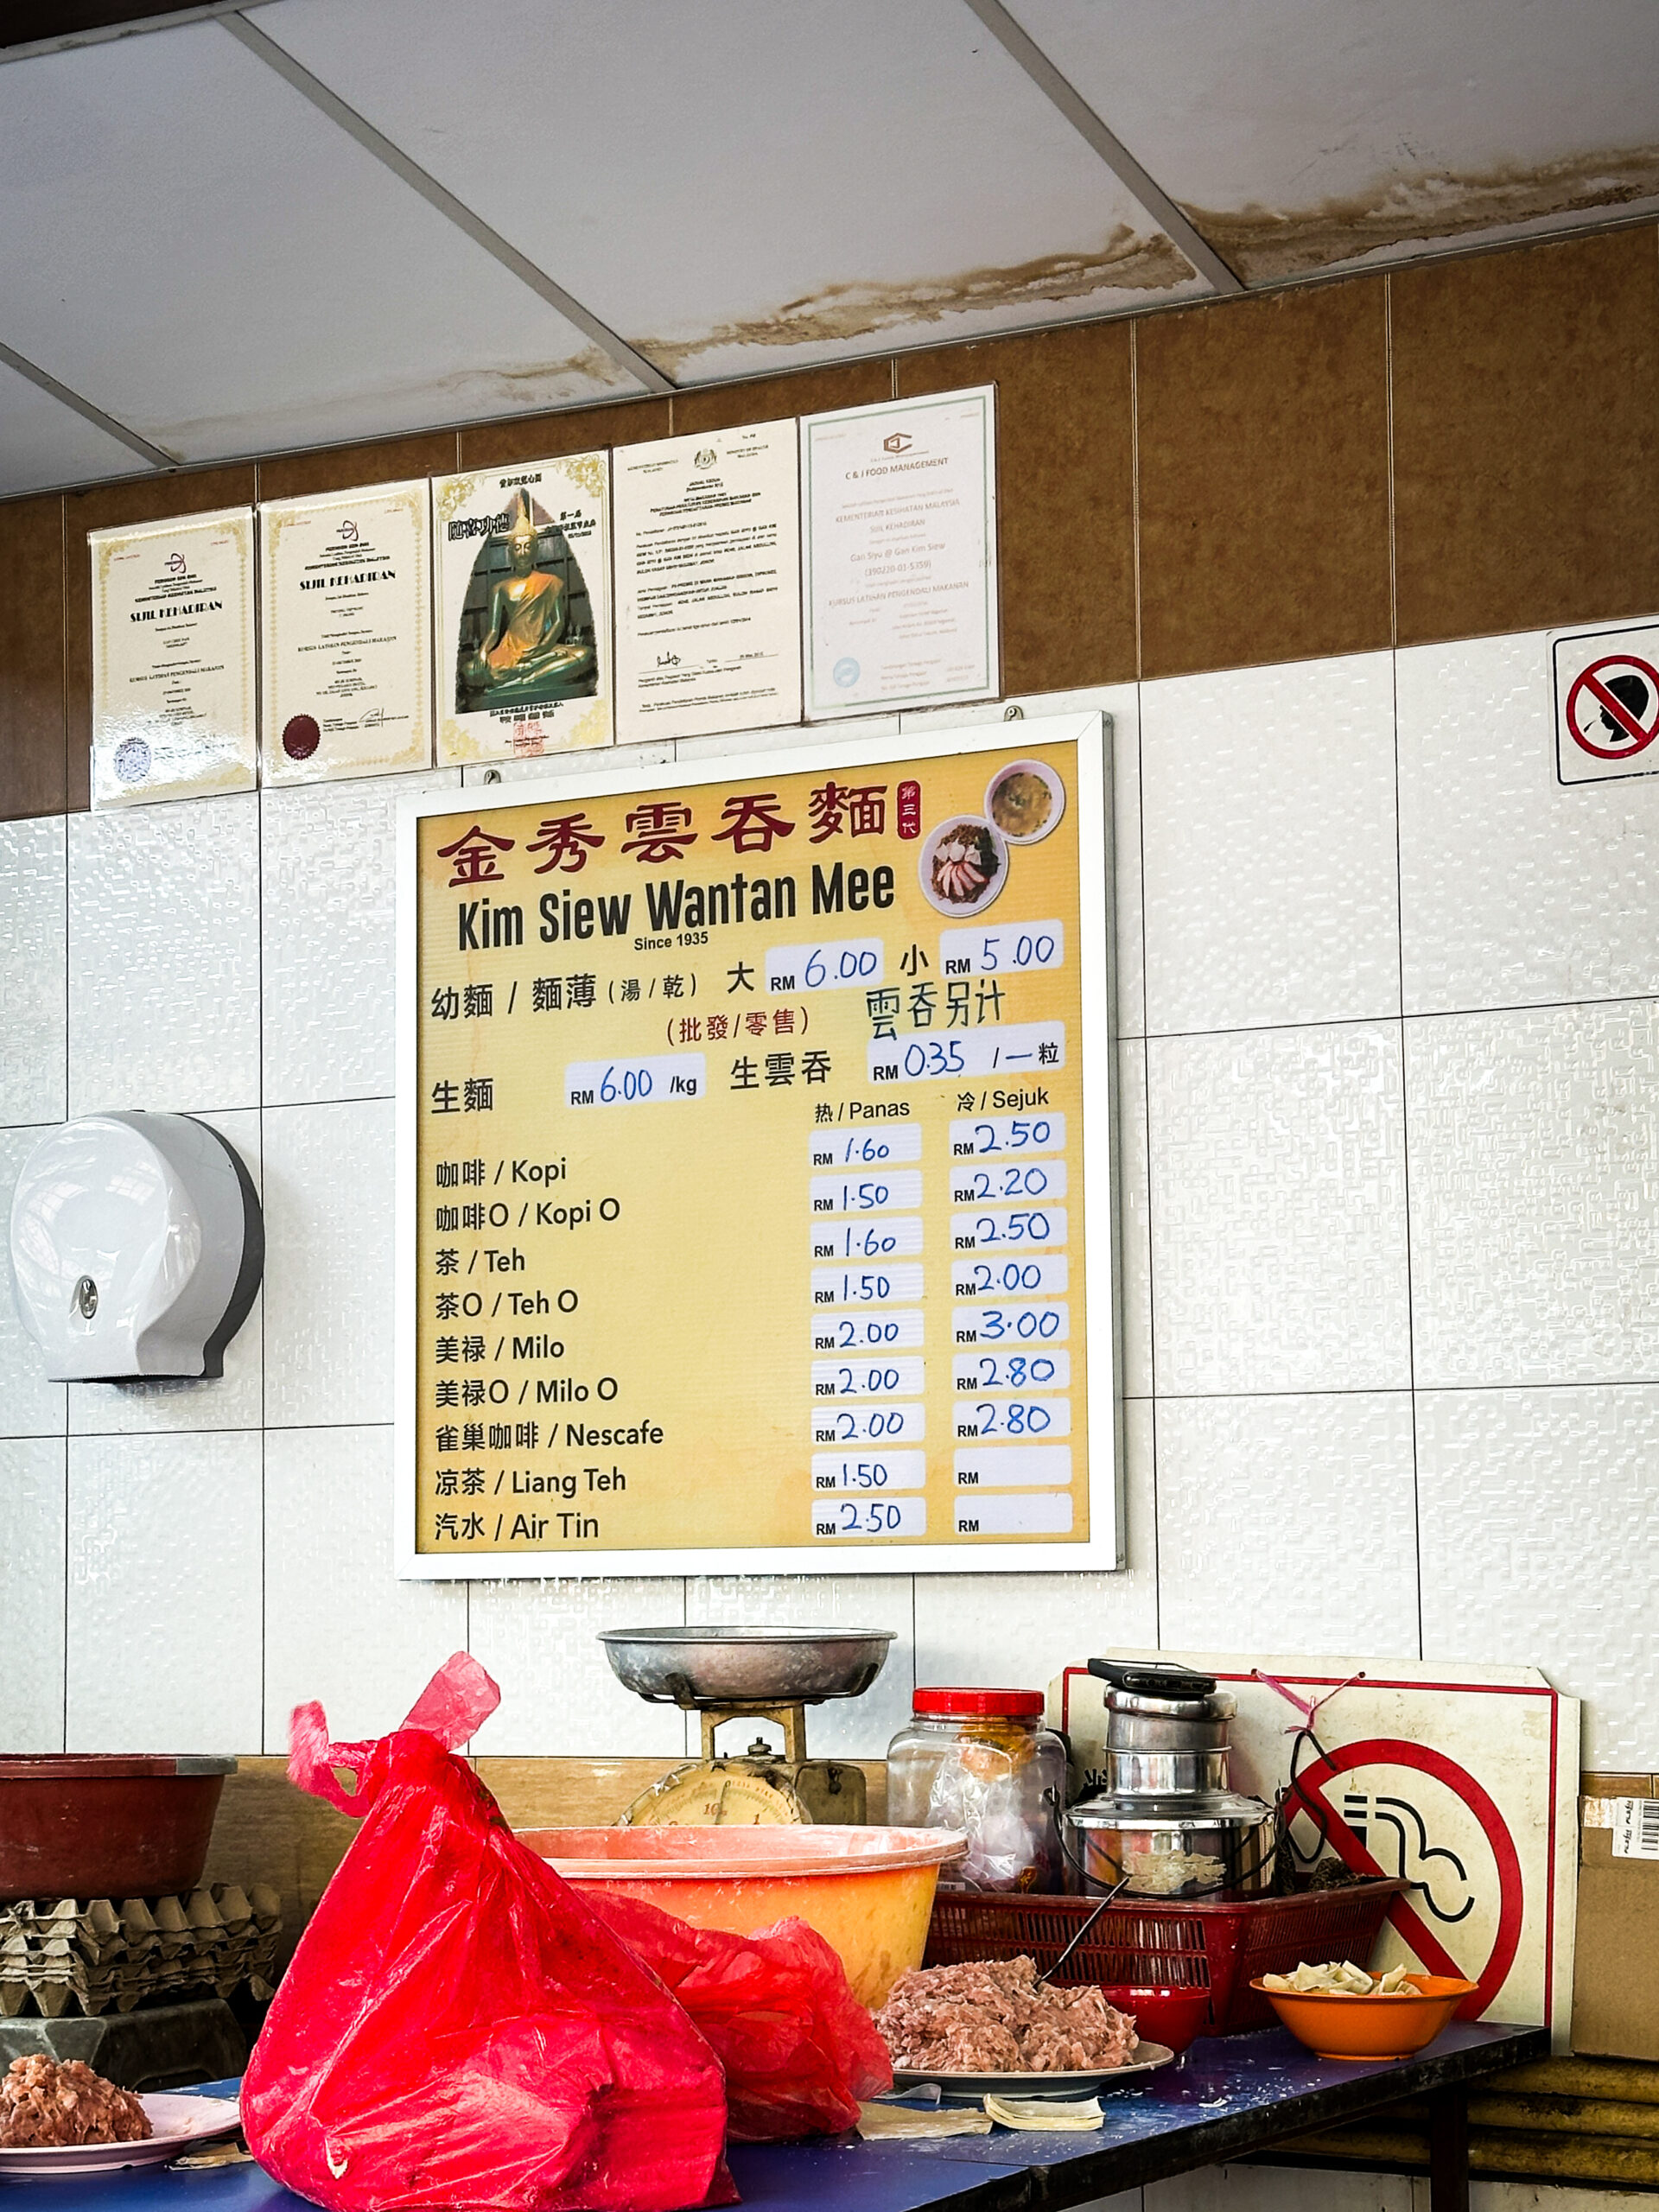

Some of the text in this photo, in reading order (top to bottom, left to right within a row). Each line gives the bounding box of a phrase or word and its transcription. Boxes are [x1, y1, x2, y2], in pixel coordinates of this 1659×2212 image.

[844, 471, 851, 480] C
[852, 469, 860, 479] &
[865, 465, 888, 477] FOOD
[890, 457, 949, 474] MANAGEMENT
[330, 570, 397, 587] KEHADIRAN
[458, 861, 894, 951] Kim Siew Wantan Mee
[633, 931, 709, 951] Since 1935
[899, 934, 1055, 977] 小 RM 5.00
[727, 949, 877, 994] 大 RM 6.00
[431, 982, 493, 1020] 幼麵
[570, 1065, 697, 1106] RM 6.00 /kg
[729, 1050, 832, 1091] 生雲吞
[873, 1065, 899, 1081] RM
[430, 1077, 494, 1116] 生麵
[815, 1103, 833, 1123] 热
[849, 1101, 910, 1121] Panas
[957, 1090, 976, 1113] 冷
[992, 1086, 1050, 1111] Sejuk
[813, 1136, 890, 1166] RM 1.60
[953, 1120, 1051, 1156] RM 2.50
[435, 1157, 486, 1188] 咖啡
[512, 1156, 567, 1188] Kopi
[953, 1167, 1048, 1203] RM 2.20
[813, 1183, 889, 1212] RM 1.50
[536, 1198, 591, 1231] Kopi
[599, 1197, 621, 1222] O
[814, 1226, 896, 1258] RM 1.60
[955, 1211, 1051, 1249] RM 2.50
[435, 1248, 460, 1276] 茶
[484, 1247, 525, 1274] Teh
[814, 1273, 890, 1304] RM 1.50
[955, 1262, 1042, 1296] RM 2.00
[507, 1289, 550, 1316] Teh
[556, 1289, 579, 1313] O
[815, 1320, 899, 1350] RM 2.00
[956, 1310, 1060, 1344] RM 3.00
[512, 1334, 565, 1360] Milo
[815, 1367, 899, 1396] RM 2.00
[957, 1357, 1055, 1391] RM 2.80
[536, 1377, 589, 1404] Milo
[596, 1376, 619, 1402] O
[435, 1420, 540, 1453] 雀巢咖啡
[565, 1418, 664, 1447] Nescafe
[815, 1412, 905, 1443] RM 2.00
[957, 1402, 1051, 1438] RM 2.80
[435, 1466, 486, 1497] 凉茶
[512, 1470, 577, 1500] Liang
[583, 1465, 626, 1492] Teh
[816, 1462, 888, 1489] RM 1.50
[957, 1471, 980, 1485] RM
[435, 1511, 486, 1542] 汽水
[510, 1512, 550, 1541] Air
[556, 1512, 600, 1540] Tin
[816, 1502, 901, 1536] RM 2.50
[957, 1519, 980, 1534] RM
